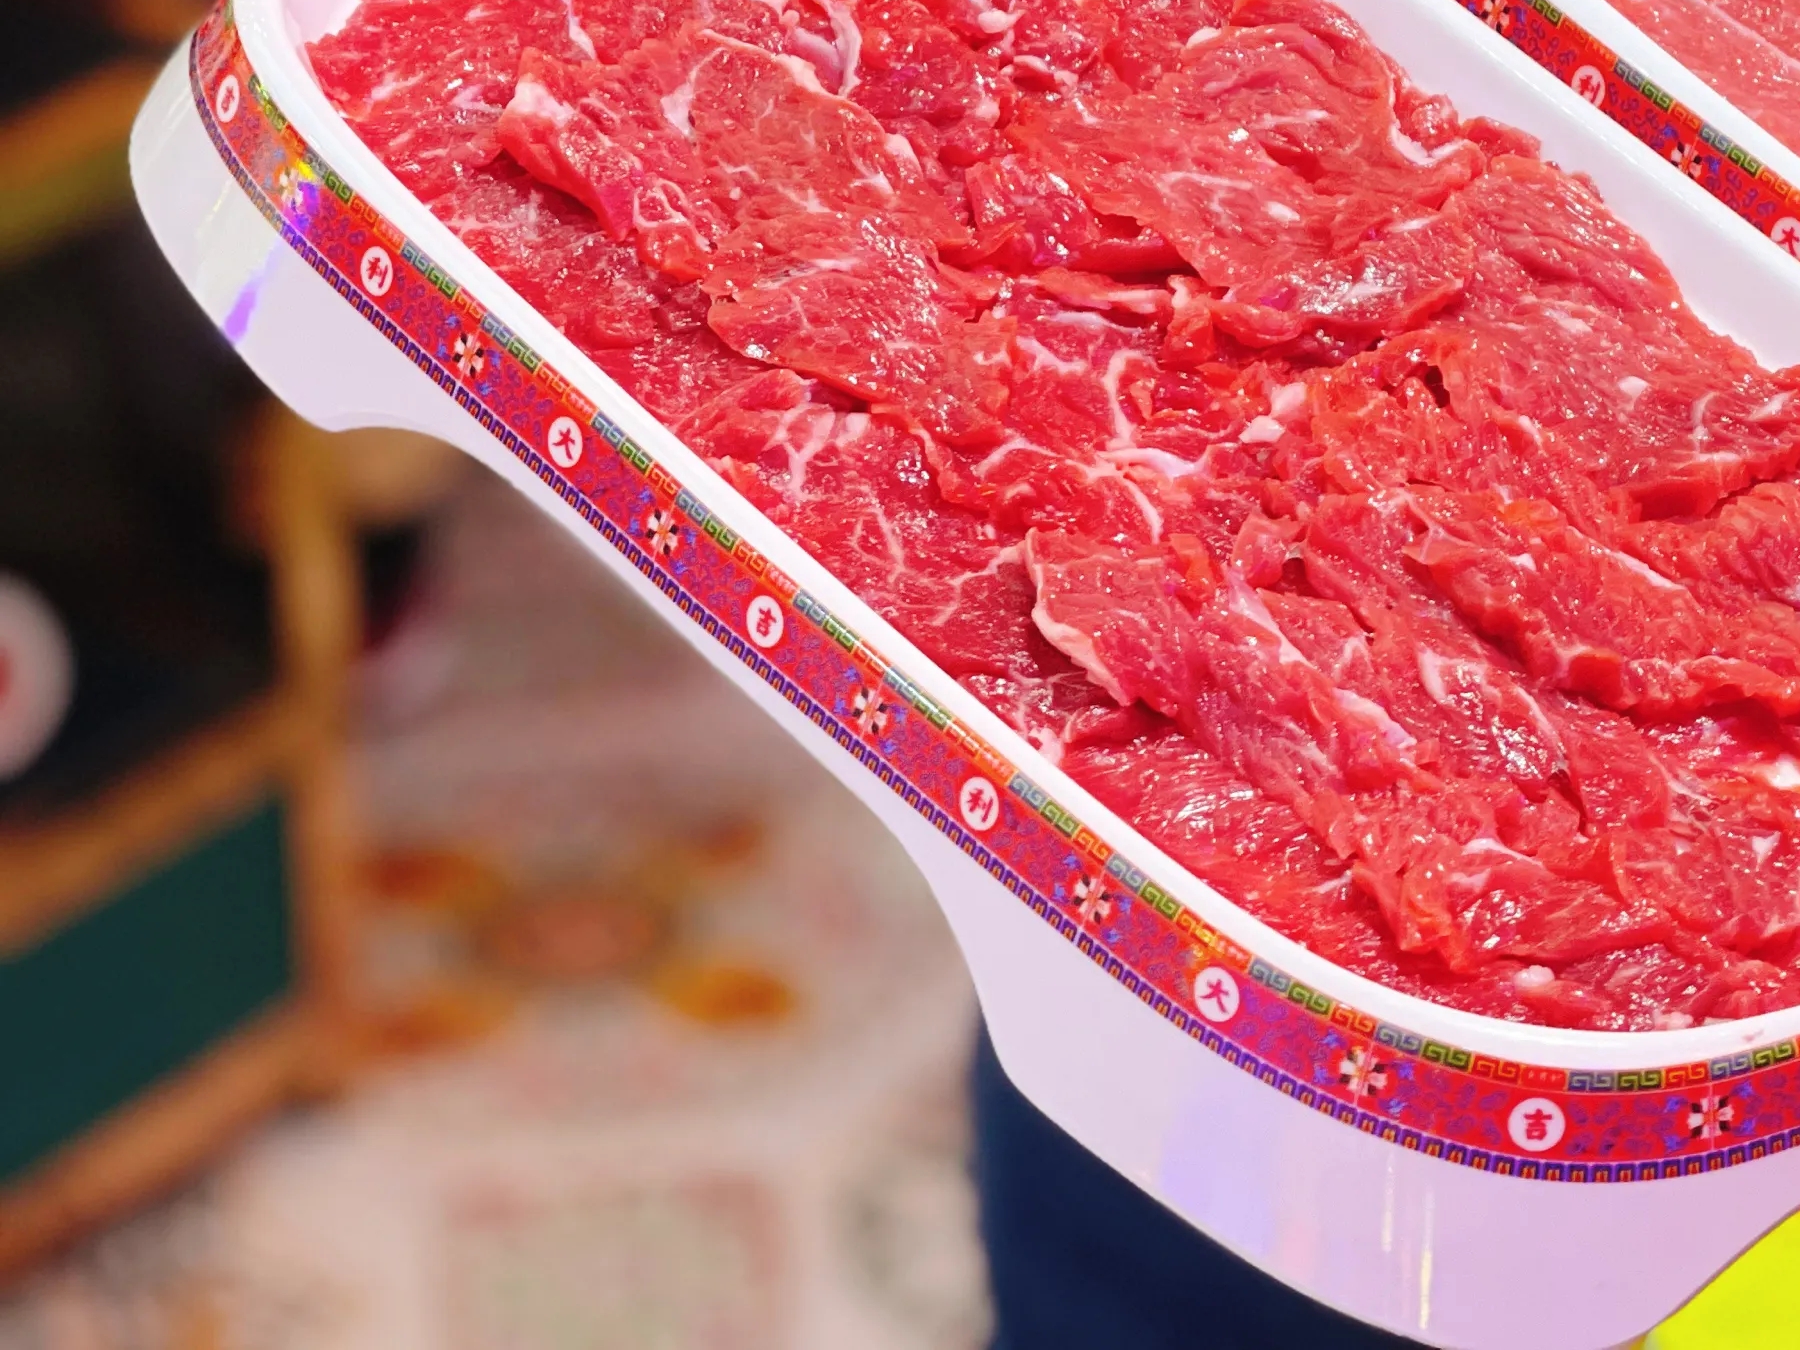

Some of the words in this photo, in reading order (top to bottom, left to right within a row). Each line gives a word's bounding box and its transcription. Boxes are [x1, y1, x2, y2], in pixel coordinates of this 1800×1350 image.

[1775, 225, 1800, 259] 大
[366, 256, 389, 290] 利
[553, 427, 576, 461] 大
[756, 606, 778, 638] 吉
[967, 788, 994, 824] 利
[1199, 977, 1231, 1015] 大
[1523, 1108, 1554, 1142] 吉
